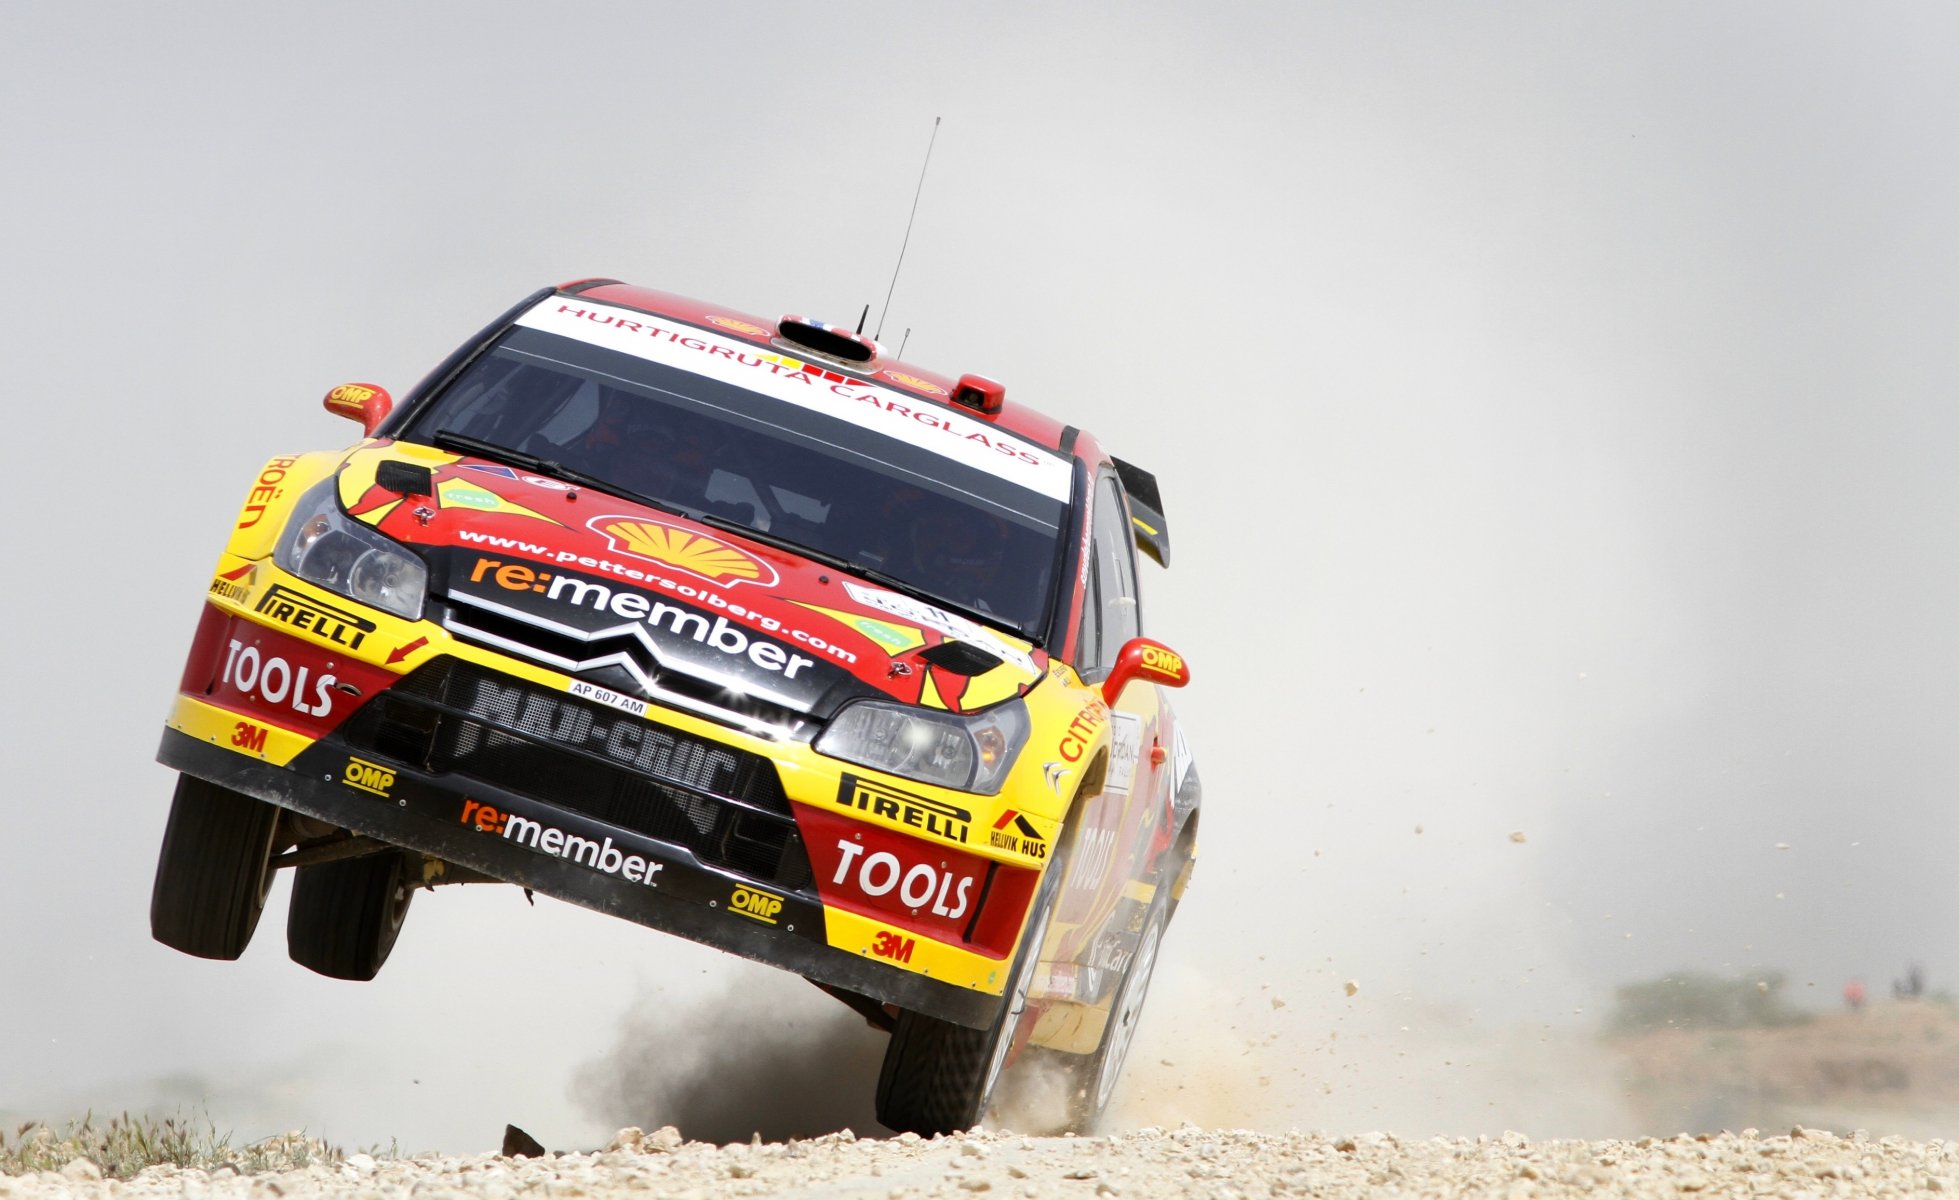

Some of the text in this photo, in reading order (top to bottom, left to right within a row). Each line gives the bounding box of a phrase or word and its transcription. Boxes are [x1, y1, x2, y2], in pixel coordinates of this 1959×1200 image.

[331, 385, 372, 403] OMP
[556, 303, 1040, 466] HURTIGRUTA CARGLASS
[254, 583, 377, 650] PIRELLI
[458, 529, 857, 664] www.pettersolberg.com
[469, 557, 814, 679] re:member
[222, 640, 338, 717] TOOLS
[1142, 647, 1181, 672] OMP
[573, 683, 644, 714] AP 607 AM
[231, 721, 268, 753] 3M
[1059, 699, 1108, 763] CITR
[345, 760, 394, 794] OMP
[836, 771, 972, 844] PIRELLI
[462, 799, 663, 886] re:member
[991, 831, 1046, 858] HELLVIK HUS
[731, 889, 782, 917] OMP
[832, 839, 974, 919] TOOLS
[872, 931, 915, 963] 3M
